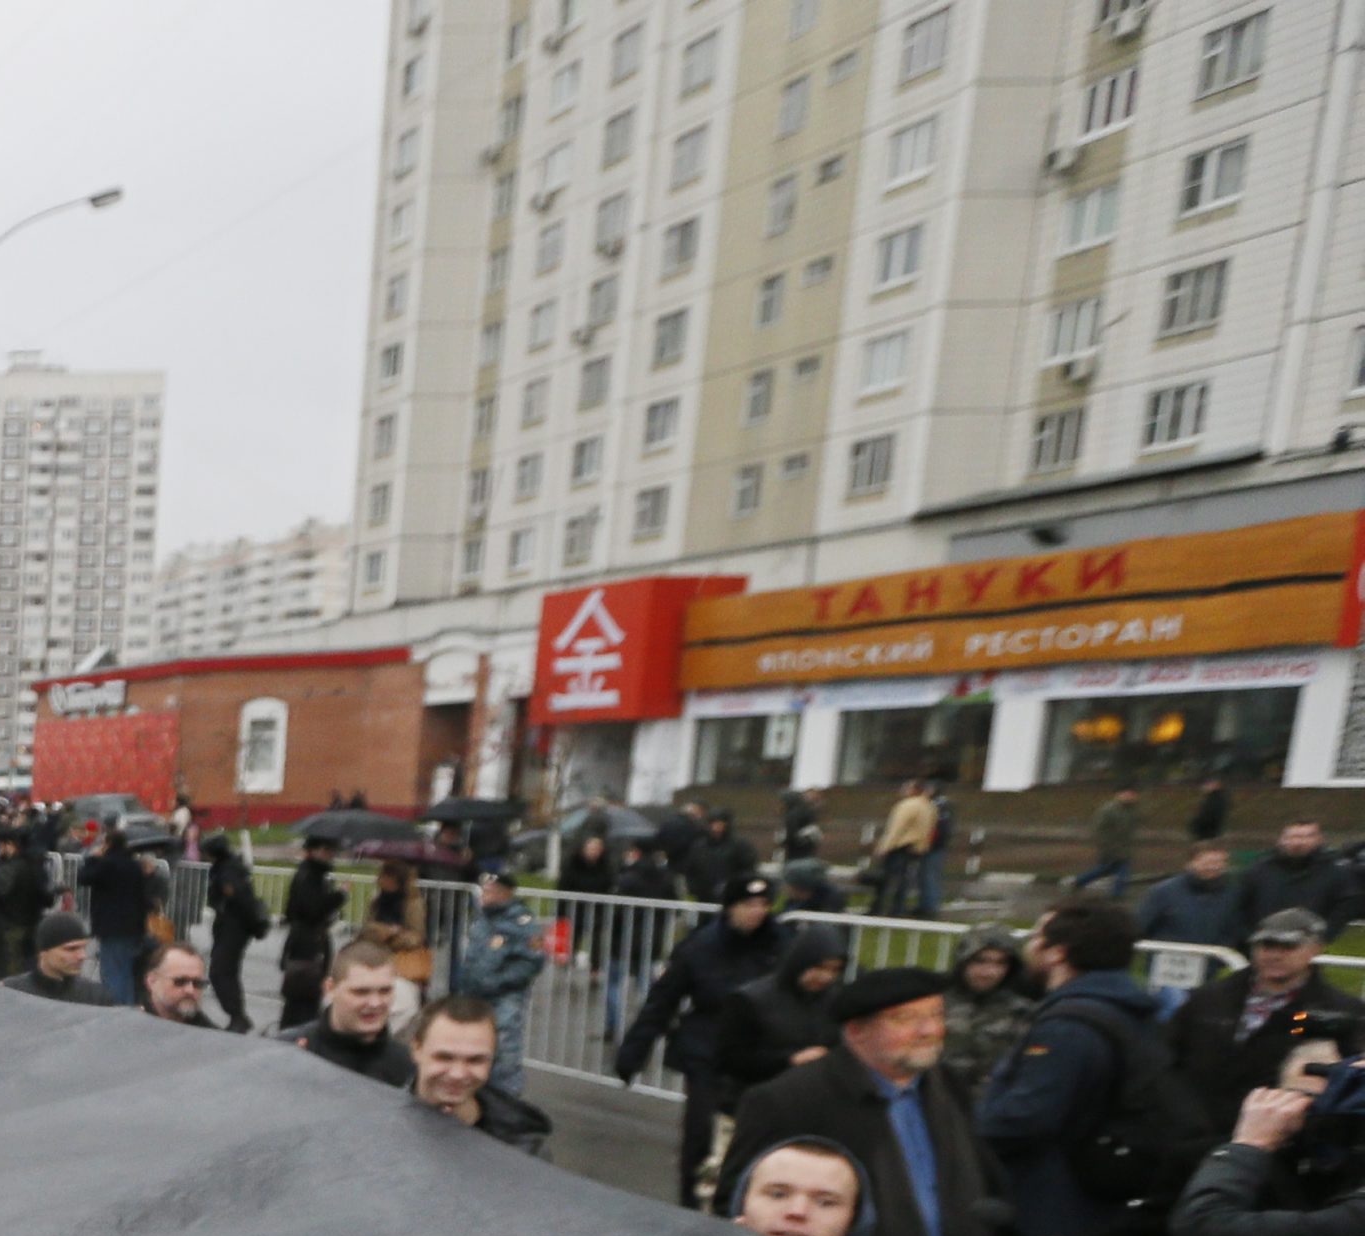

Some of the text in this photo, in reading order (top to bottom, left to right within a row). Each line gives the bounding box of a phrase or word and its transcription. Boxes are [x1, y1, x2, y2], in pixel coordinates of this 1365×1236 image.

[811, 550, 1130, 620] ТАНУКИ
[756, 615, 1186, 673] ЯПОНСКИЙ РЕСТОРАН
